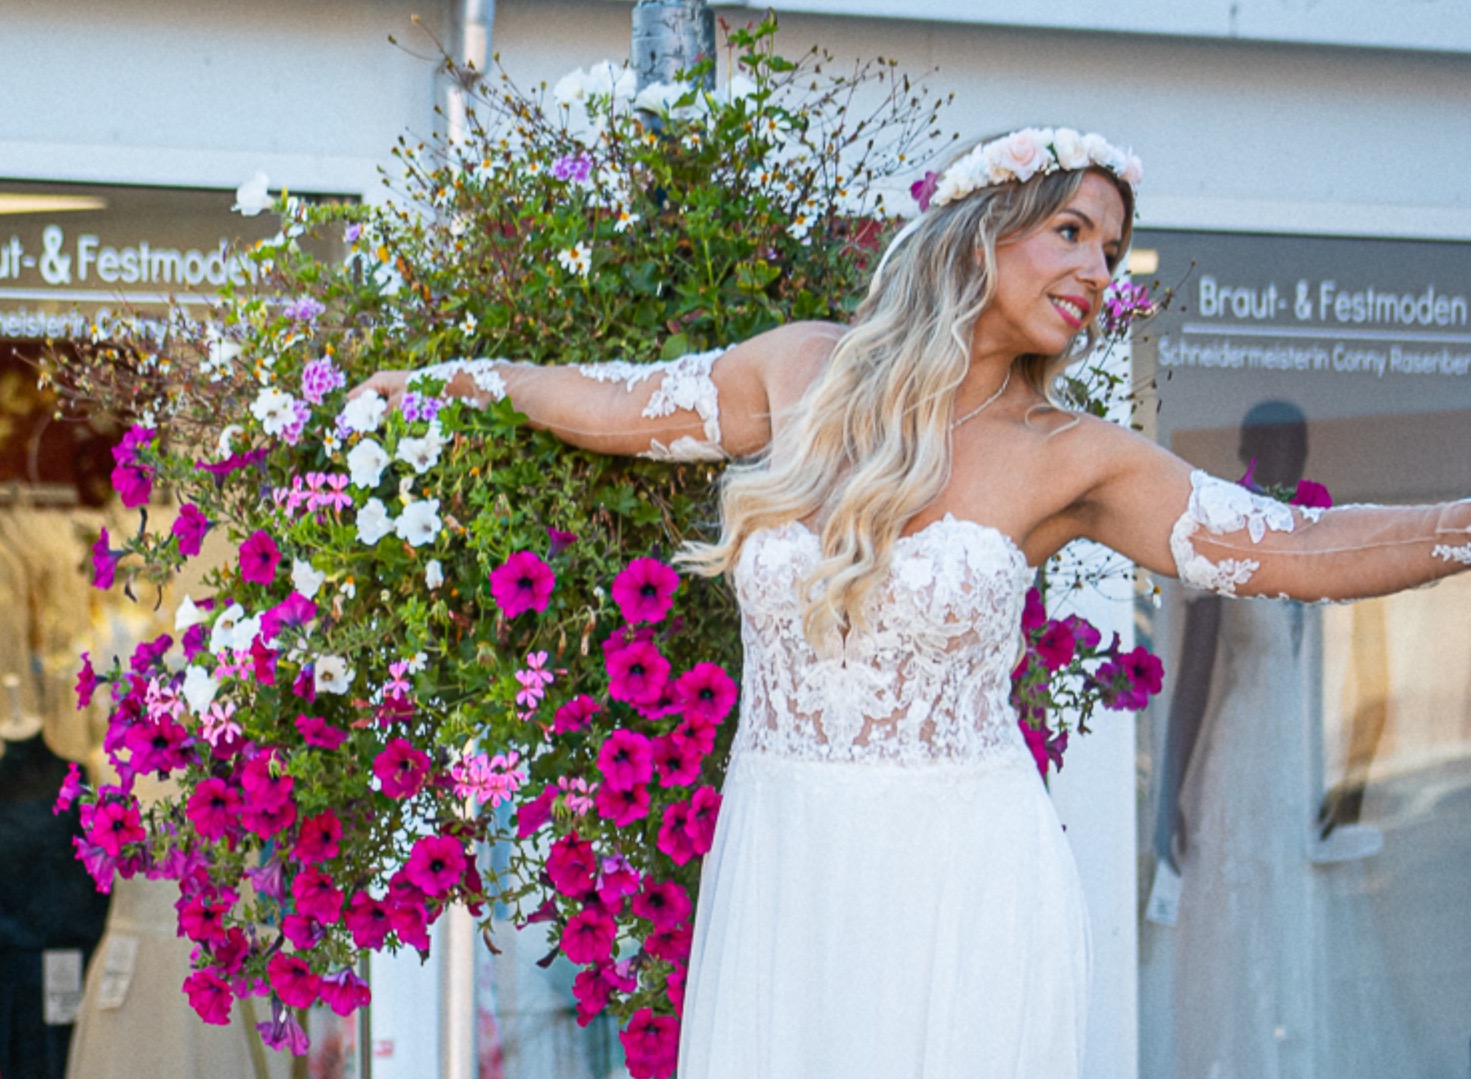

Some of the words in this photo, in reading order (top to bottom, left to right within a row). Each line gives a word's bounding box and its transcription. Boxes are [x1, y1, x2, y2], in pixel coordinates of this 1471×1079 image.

[39, 224, 72, 285] &
[1199, 275, 1288, 318] Braut-
[1294, 279, 1313, 321] &
[1319, 280, 1468, 326] Festmoden
[1157, 335, 1328, 370] Schneidermeisterin
[1332, 343, 1386, 379] Conny
